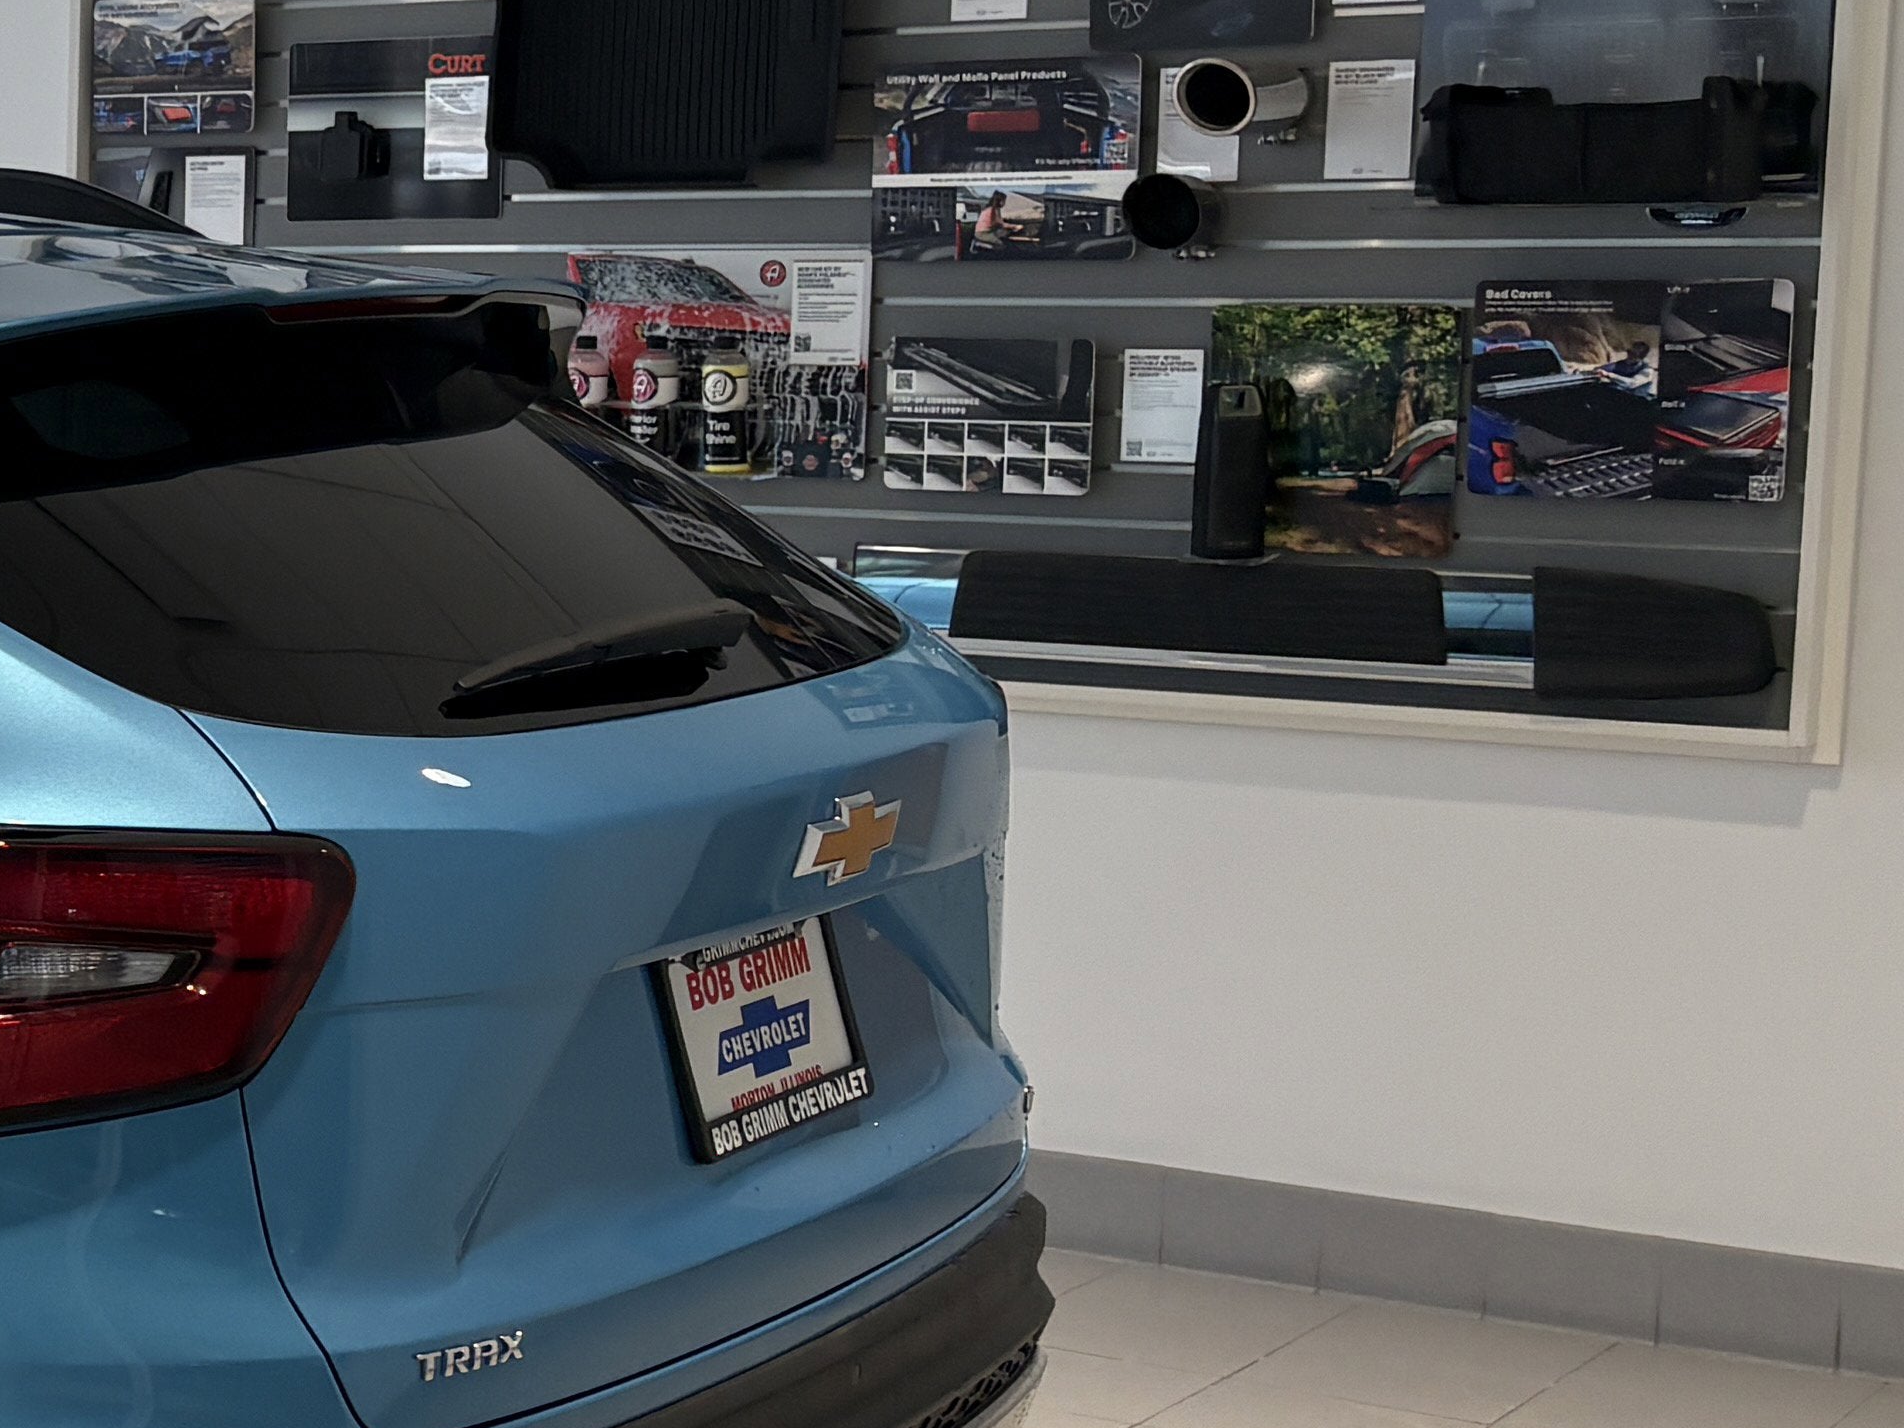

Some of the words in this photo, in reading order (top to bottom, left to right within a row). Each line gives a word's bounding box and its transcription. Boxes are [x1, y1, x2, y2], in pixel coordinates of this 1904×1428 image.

[428, 53, 486, 74] CURT
[886, 74, 916, 86] Utility
[918, 72, 939, 84] Wall
[942, 72, 960, 83] and
[991, 70, 1019, 82] Panel
[1021, 69, 1067, 80] Products
[1510, 288, 1552, 299] Covers
[707, 419, 730, 431] Tire
[686, 962, 735, 1011] BOB
[739, 937, 811, 992] GRIMM
[721, 1012, 807, 1063] CHEVROLET
[712, 1120, 742, 1156] BOB
[742, 1100, 790, 1142] GRIMM
[788, 1067, 868, 1122] CHEVROLET
[416, 1330, 524, 1382] TRAX
